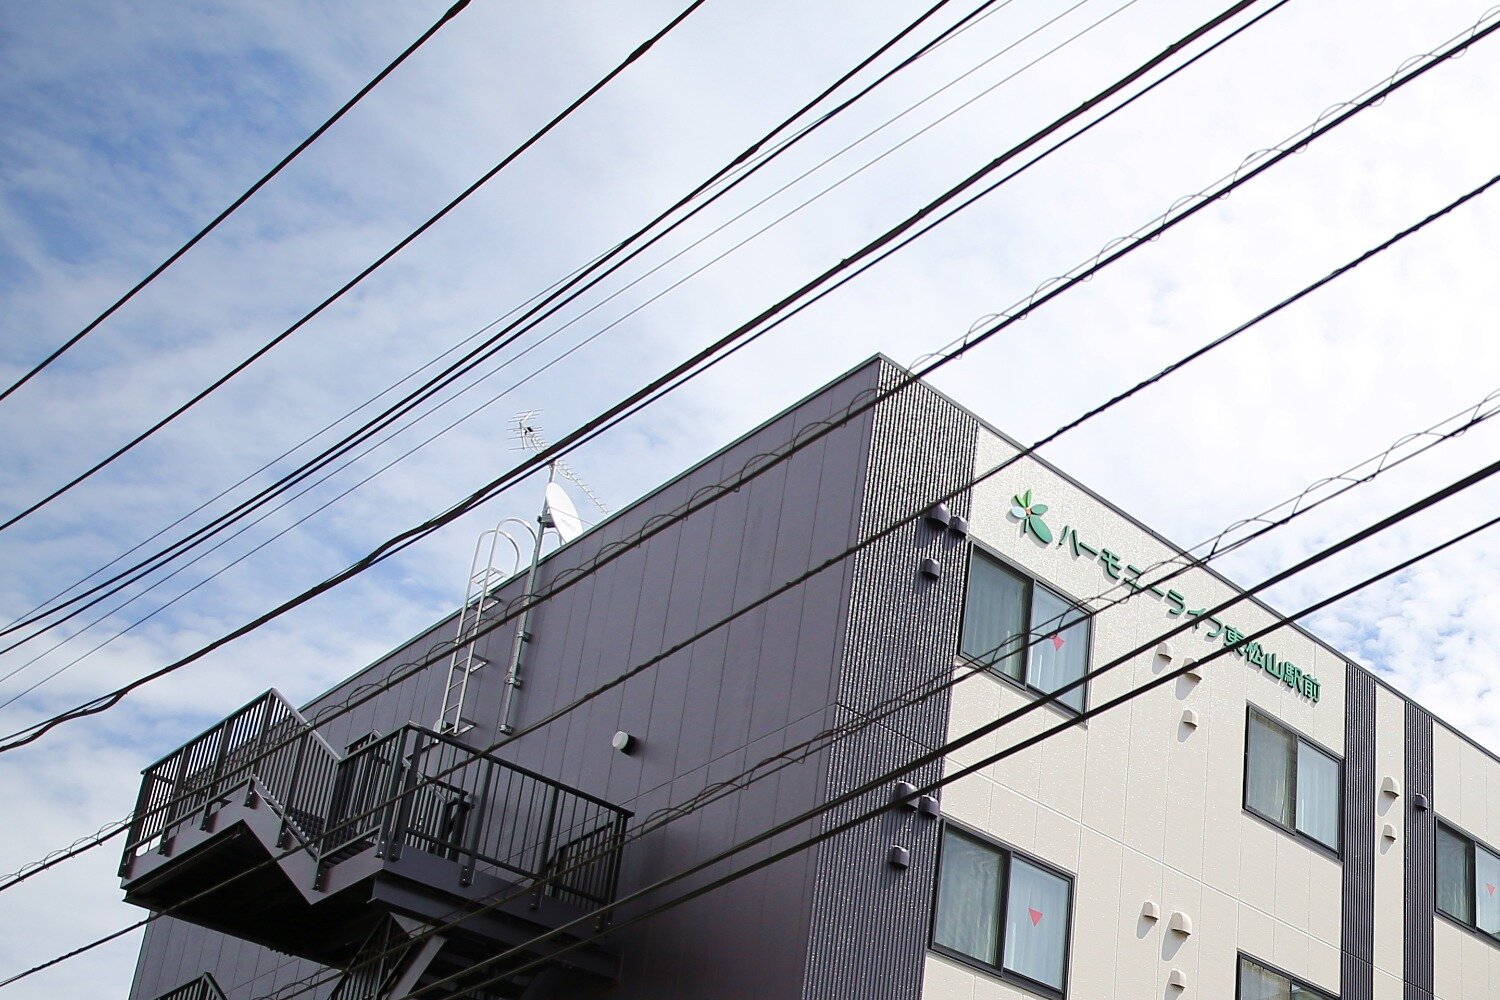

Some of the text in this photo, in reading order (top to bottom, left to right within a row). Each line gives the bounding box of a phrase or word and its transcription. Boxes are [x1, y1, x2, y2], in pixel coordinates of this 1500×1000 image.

[1059, 525, 1322, 703] ハーモニーライフ東松山駅前
